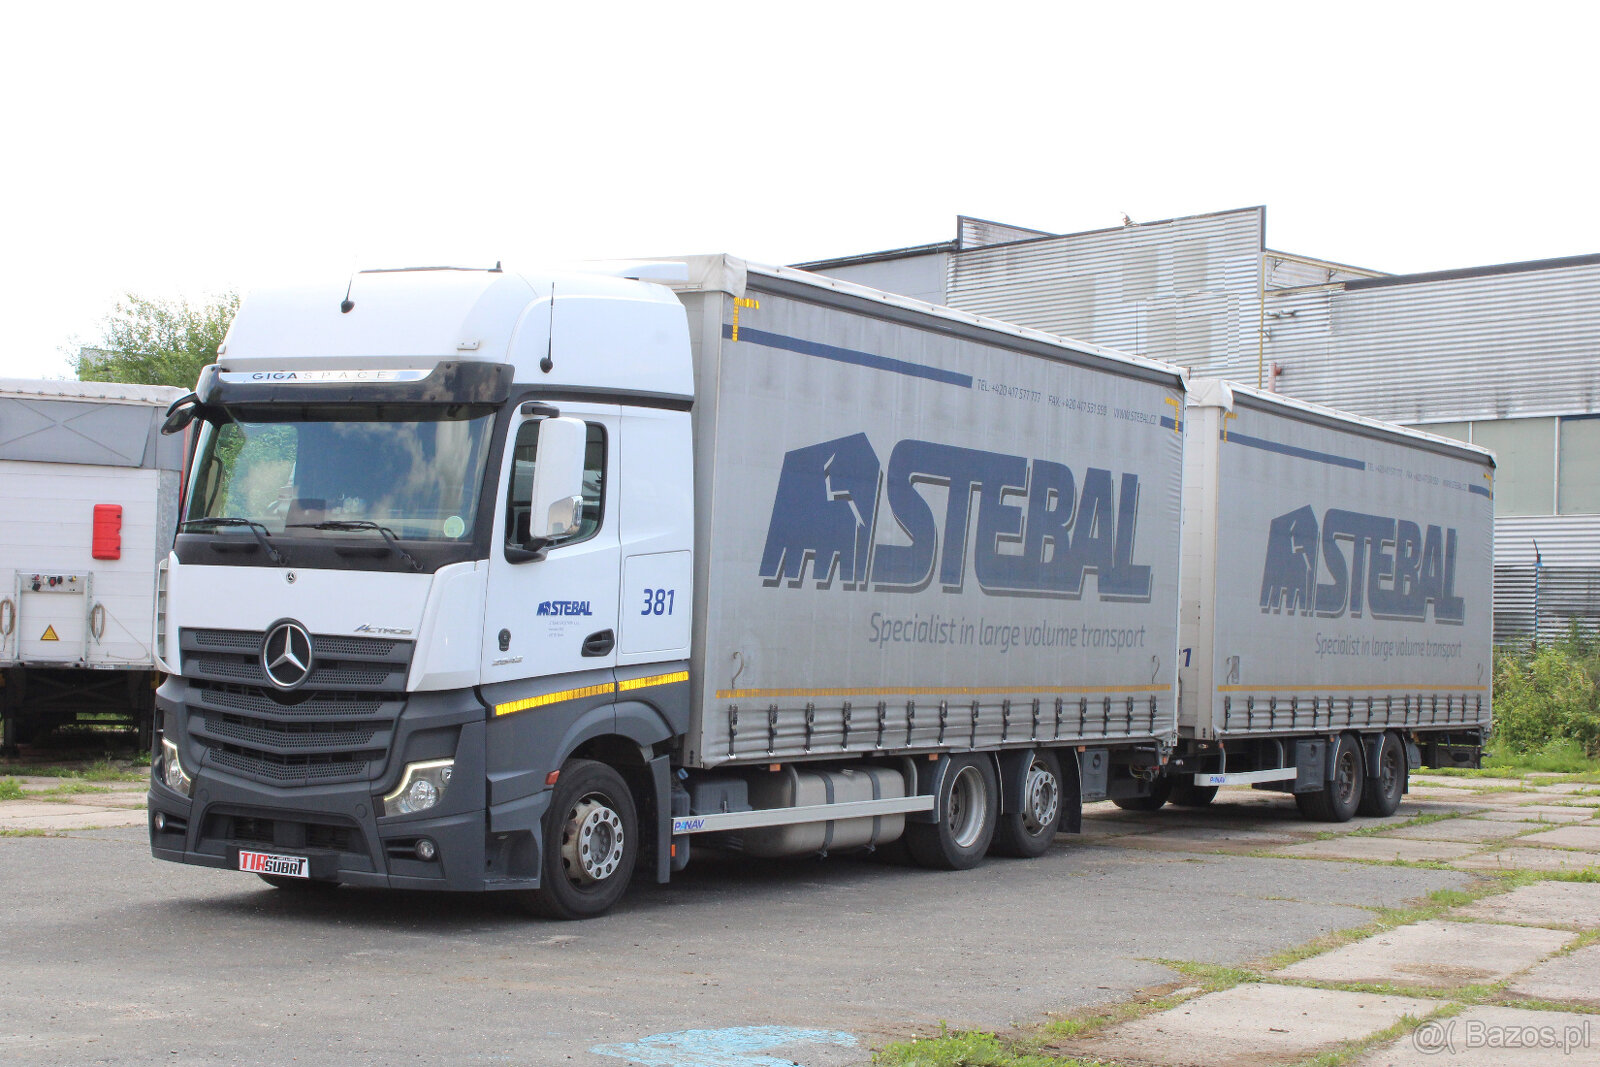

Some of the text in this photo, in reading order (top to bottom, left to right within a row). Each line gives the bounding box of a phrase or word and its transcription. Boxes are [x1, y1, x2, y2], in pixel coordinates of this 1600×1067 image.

[870, 438, 1153, 603] STEBAL
[1314, 508, 1465, 626] STEBAL
[550, 600, 593, 616] STEBAL
[641, 588, 675, 616] 381
[868, 612, 1146, 654] Specialist in large volume transport
[1314, 632, 1462, 662] Specialist in large volume transport
[674, 819, 705, 831] PANAV
